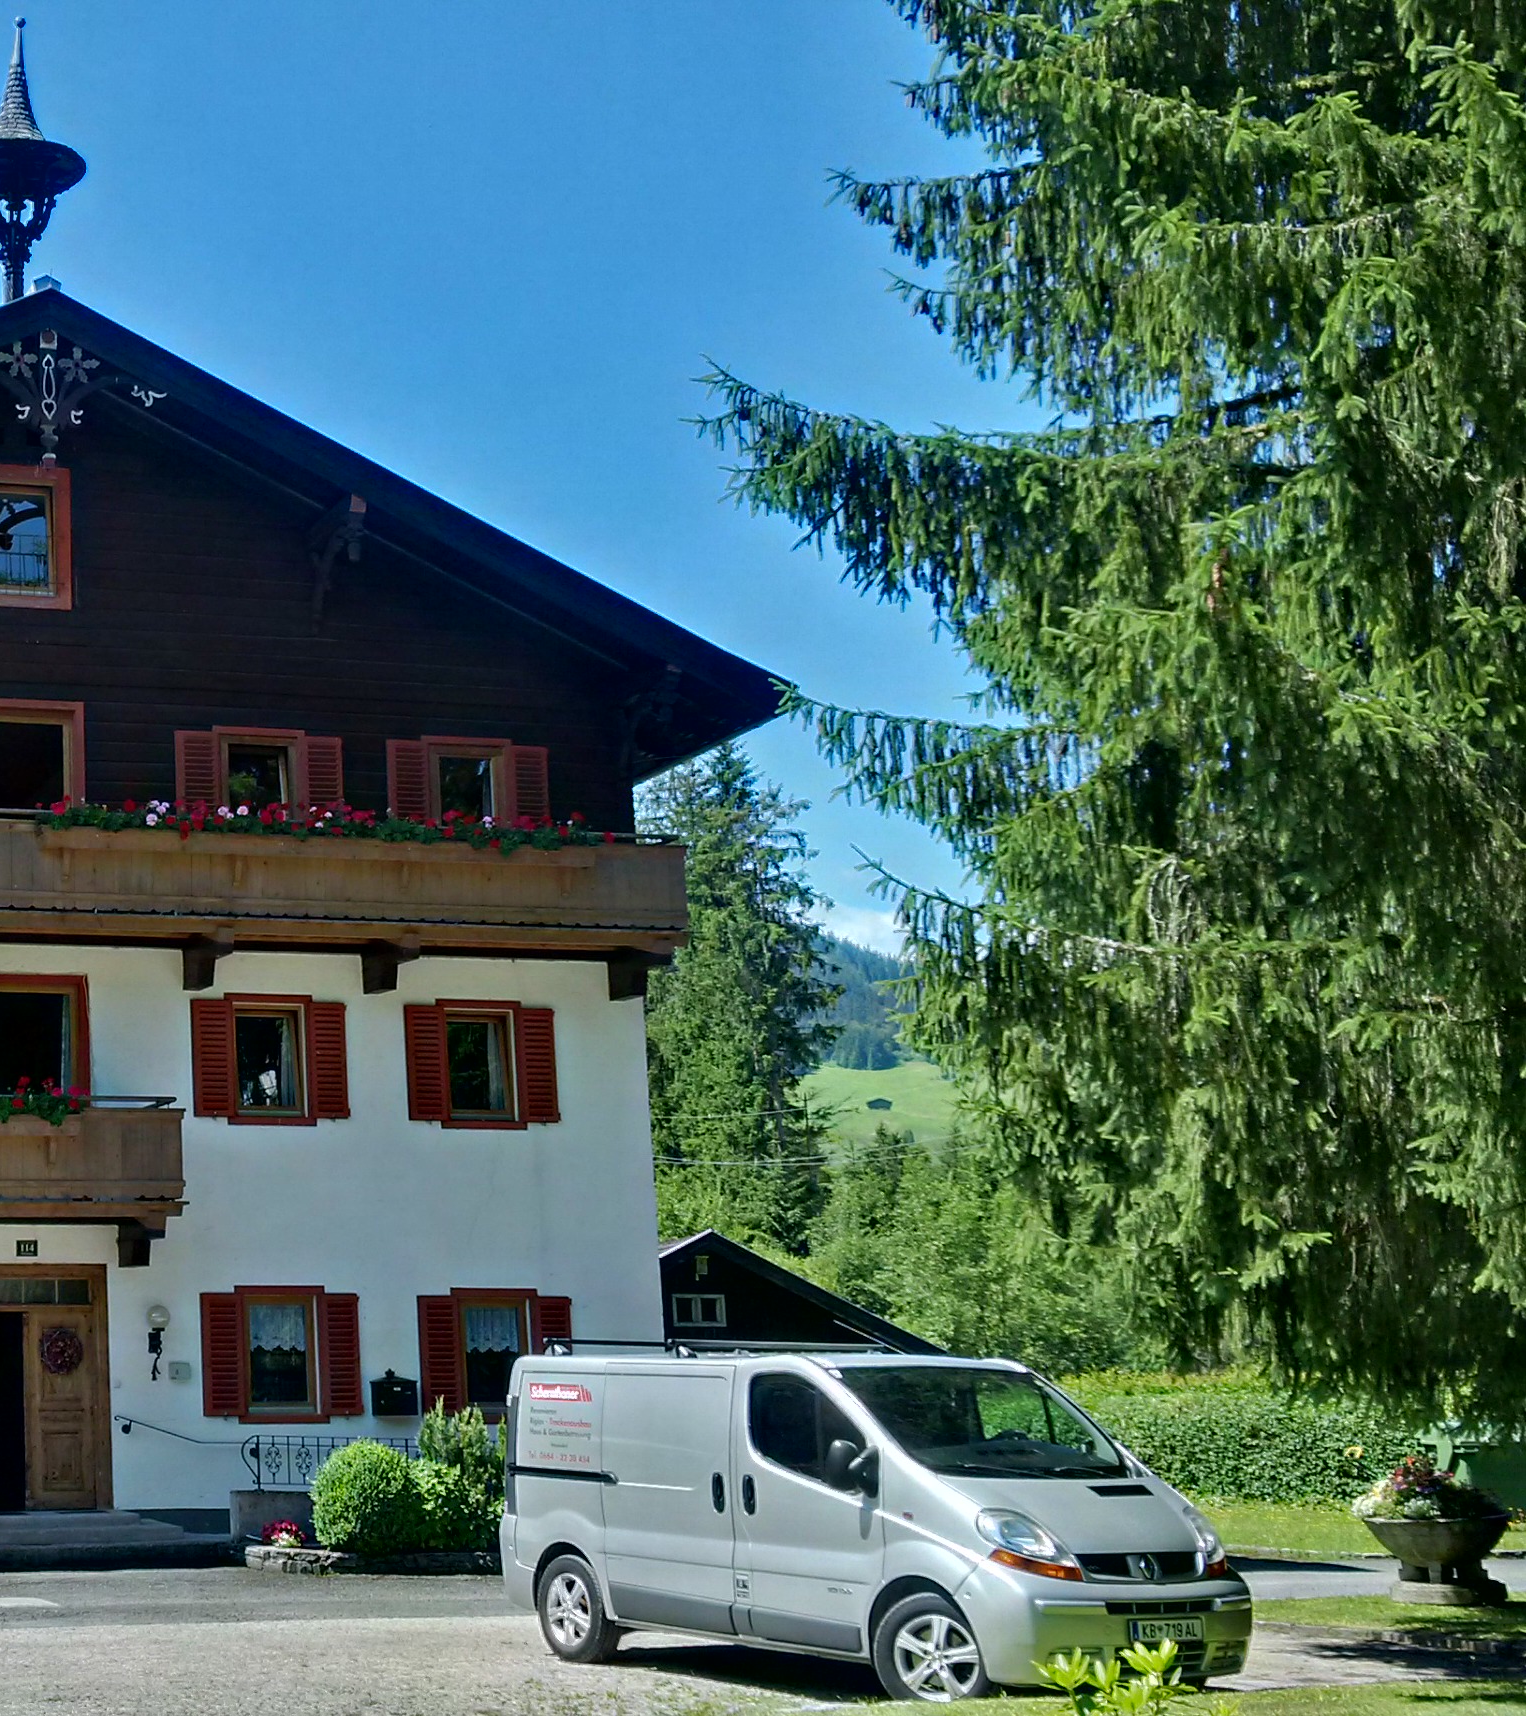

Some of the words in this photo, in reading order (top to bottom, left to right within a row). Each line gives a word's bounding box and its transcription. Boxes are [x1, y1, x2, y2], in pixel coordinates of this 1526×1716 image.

[20, 1244, 35, 1252] 114
[1142, 1623, 1156, 1639] KB
[1164, 1622, 1183, 1638] 719
[1185, 1621, 1198, 1638] AL
